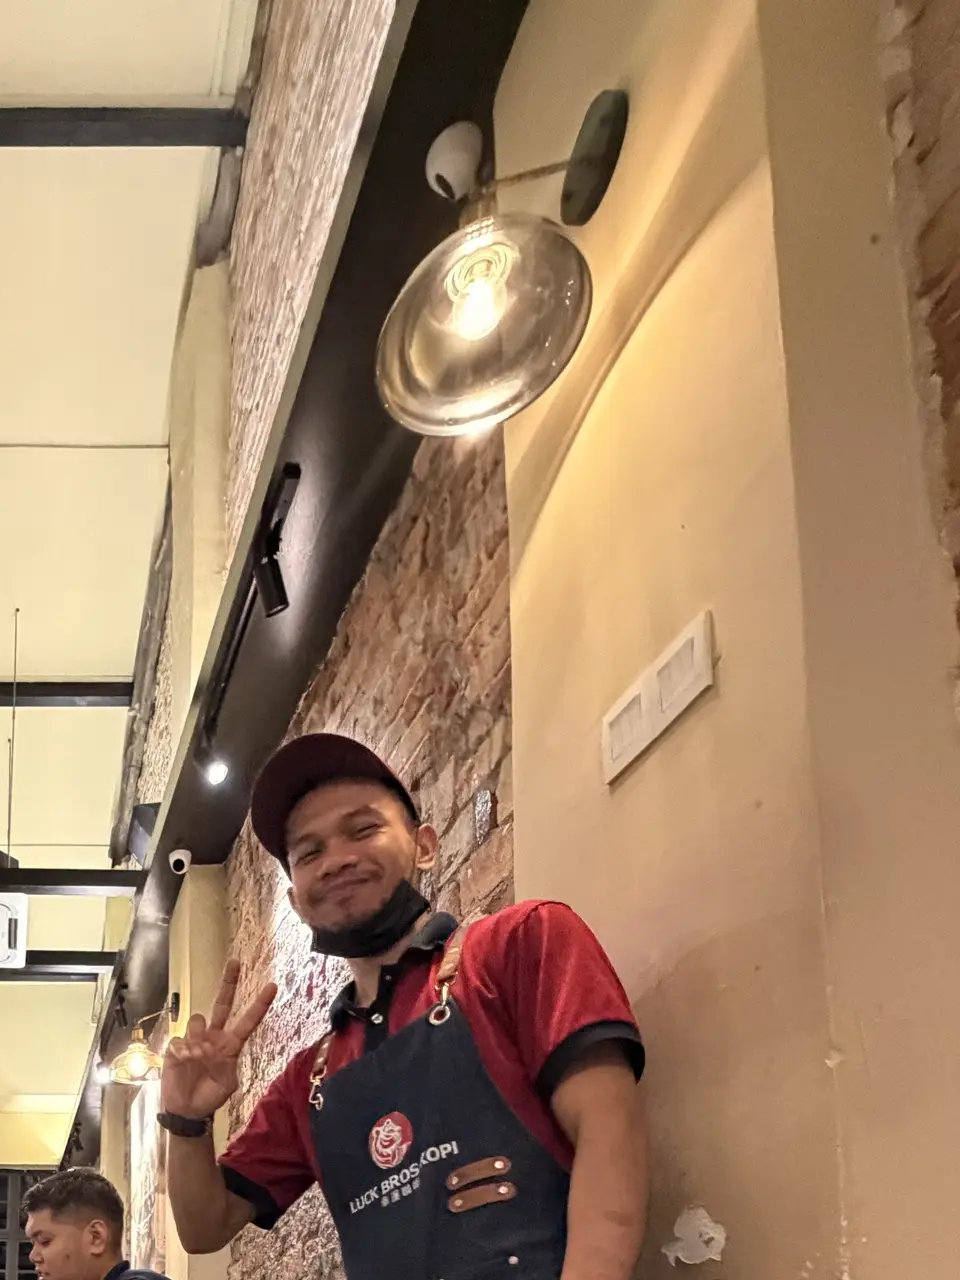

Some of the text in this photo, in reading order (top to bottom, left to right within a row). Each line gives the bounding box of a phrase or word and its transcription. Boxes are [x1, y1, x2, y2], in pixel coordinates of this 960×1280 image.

[349, 1186, 380, 1214] LUCK
[380, 1162, 420, 1196] BROS
[419, 1140, 459, 1167] KOPI
